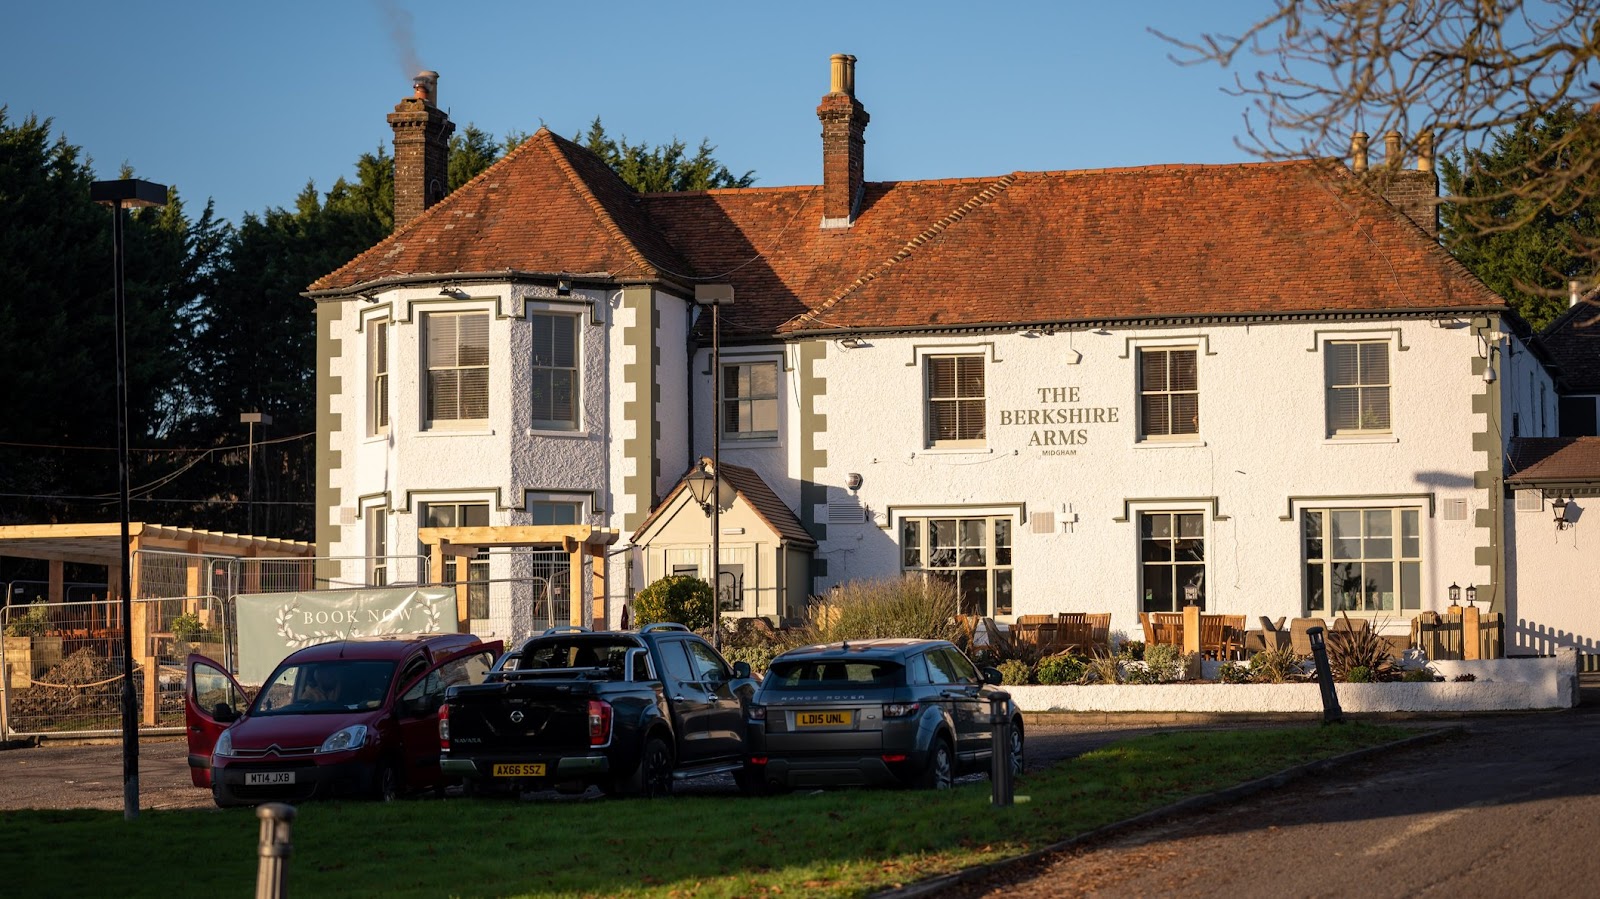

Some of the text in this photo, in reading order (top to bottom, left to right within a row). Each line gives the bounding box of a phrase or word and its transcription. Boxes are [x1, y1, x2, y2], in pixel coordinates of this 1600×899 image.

[1037, 386, 1080, 404] THE
[1000, 407, 1119, 426] BERKSHIRE
[1027, 429, 1088, 447] ARMS
[303, 607, 413, 625] BOOK NOW
[802, 714, 845, 724] LD15 UNL
[251, 773, 290, 783] MT14 JXB
[497, 765, 521, 775] AX66
